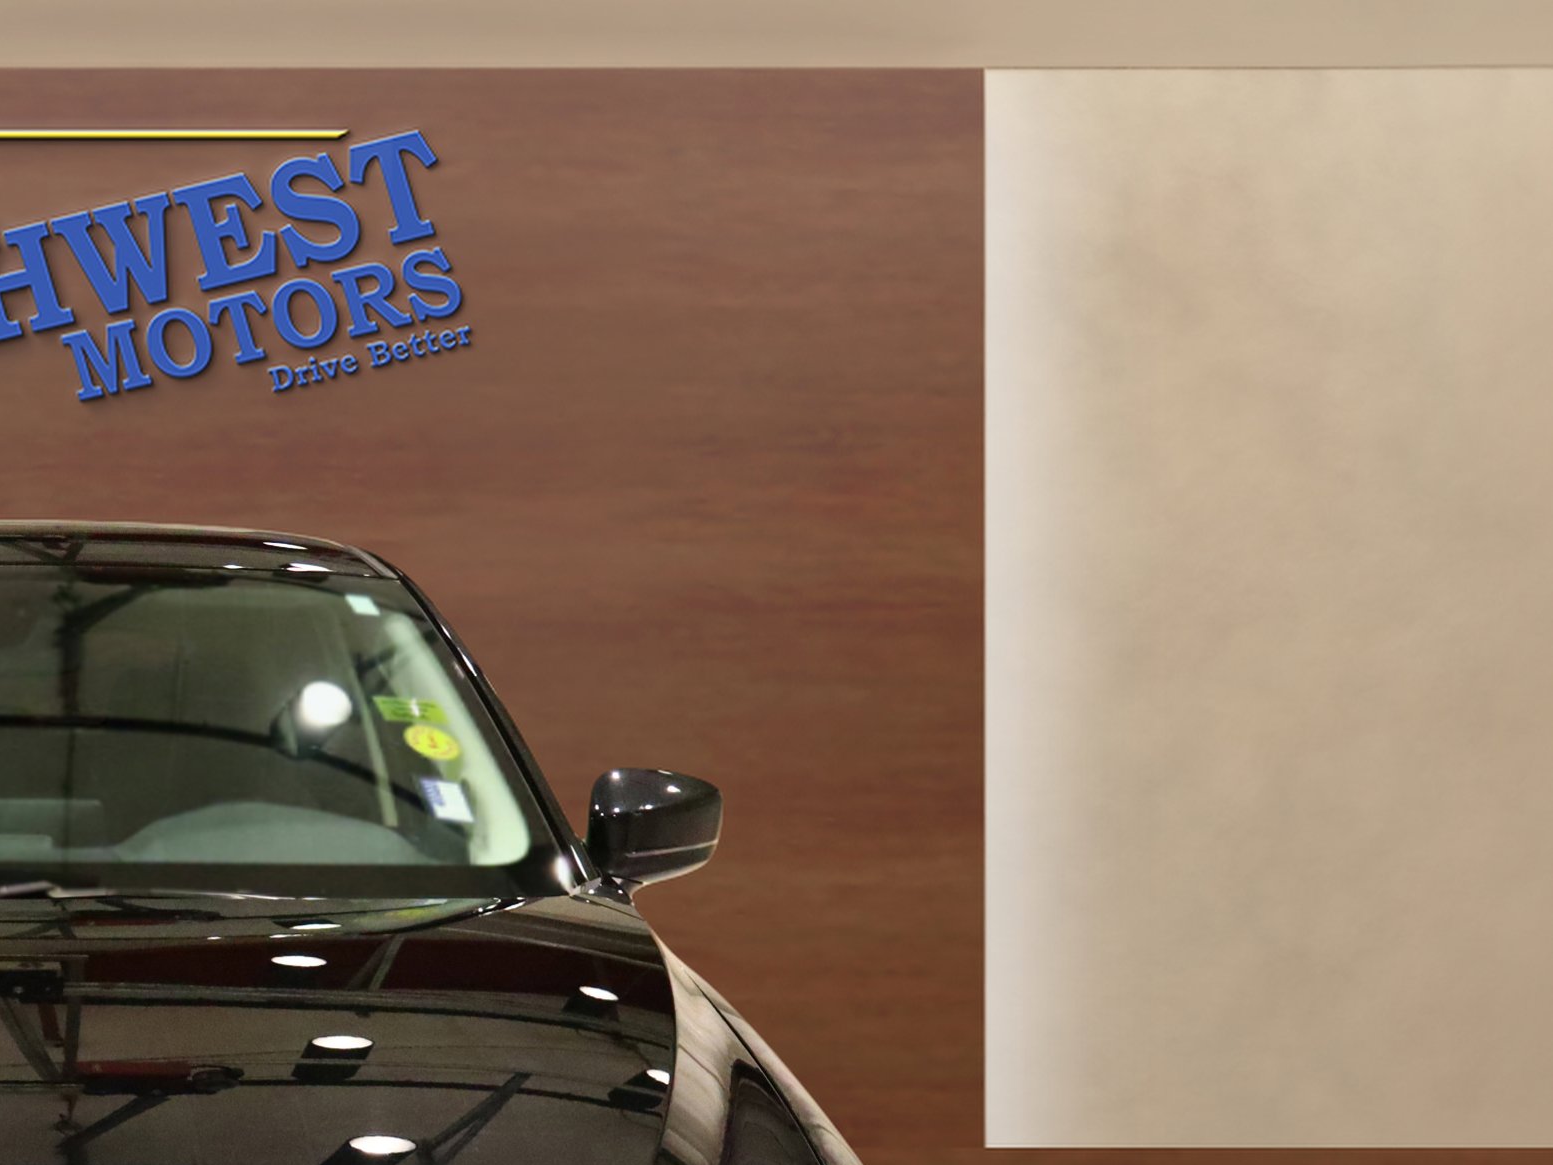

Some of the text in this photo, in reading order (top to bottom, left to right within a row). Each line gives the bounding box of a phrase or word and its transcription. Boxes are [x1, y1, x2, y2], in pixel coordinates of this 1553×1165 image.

[61, 247, 462, 401] MOTORS
[268, 325, 472, 392] Drive Better
